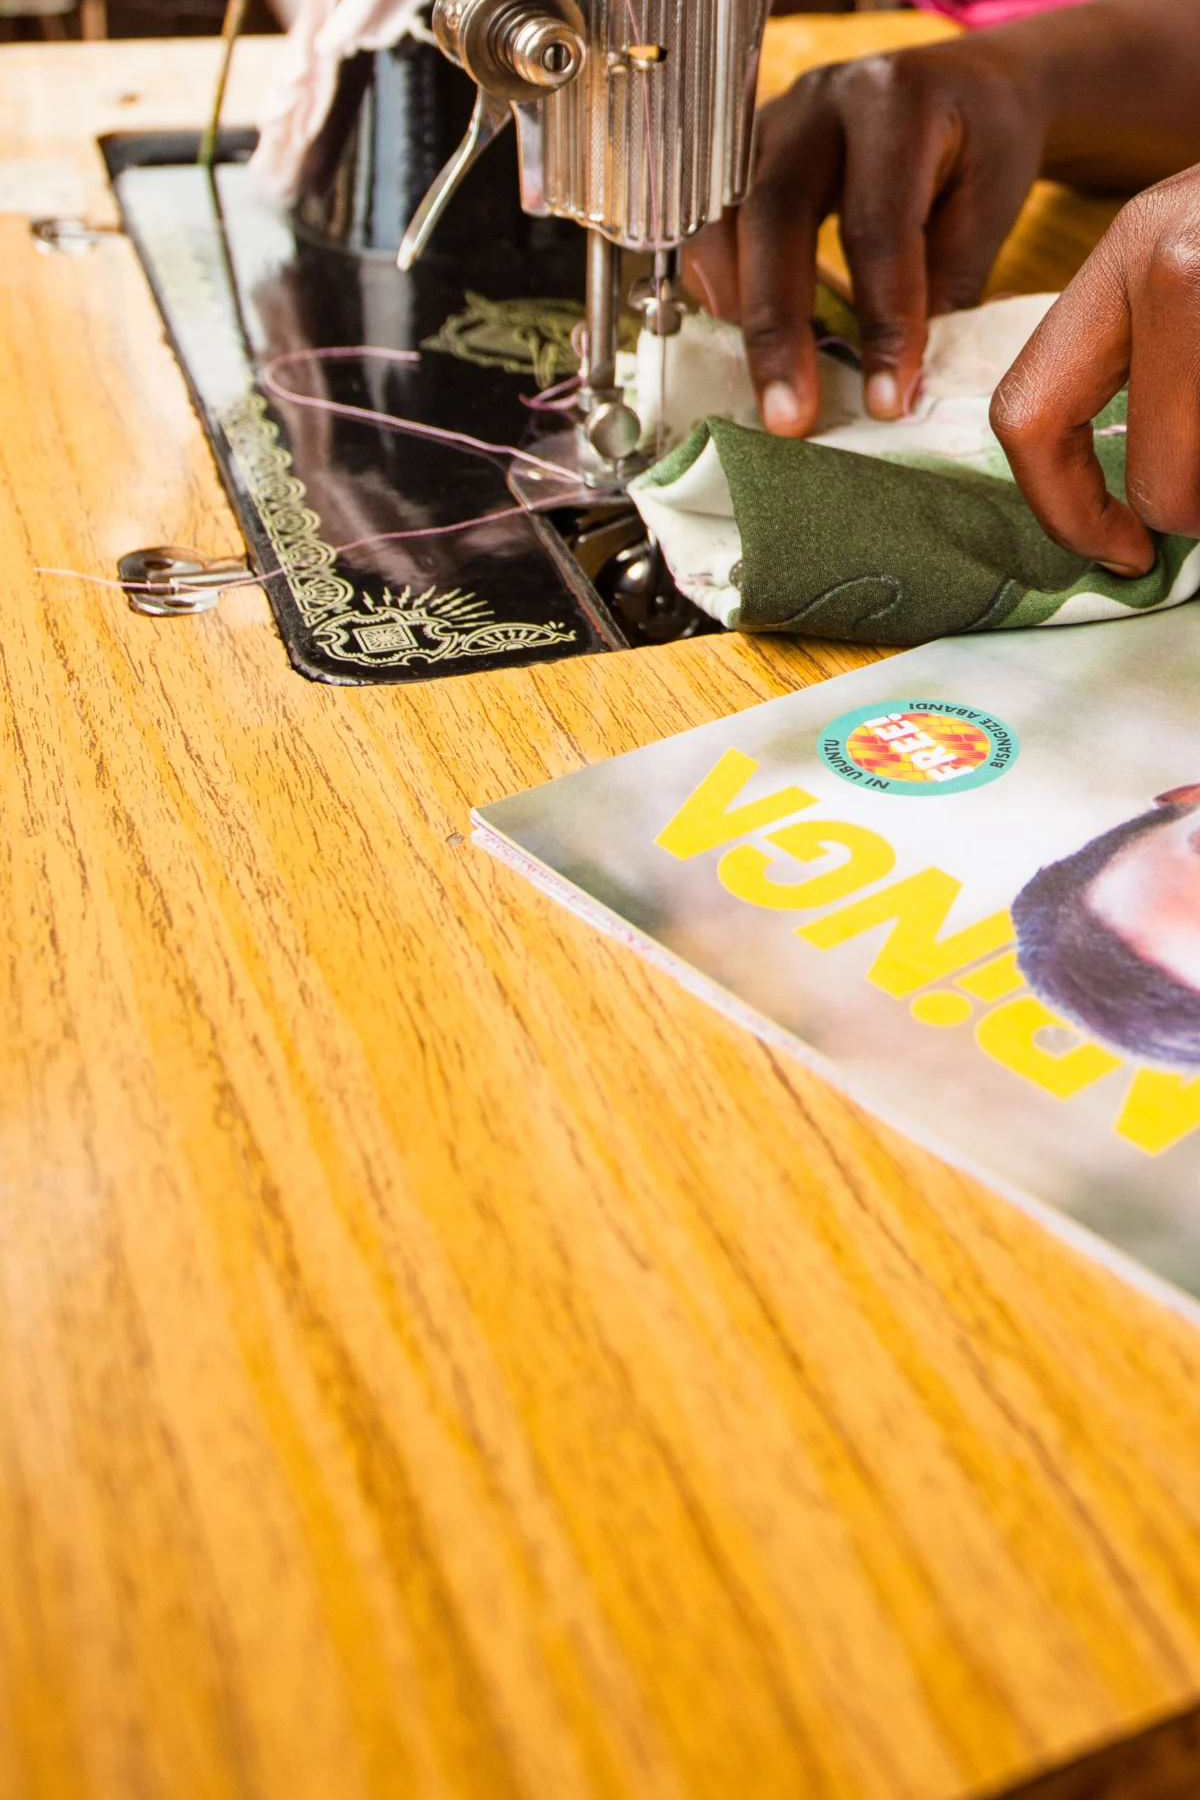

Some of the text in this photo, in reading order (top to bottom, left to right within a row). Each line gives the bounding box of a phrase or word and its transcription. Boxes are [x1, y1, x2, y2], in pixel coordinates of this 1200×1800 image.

[824, 738, 891, 790] NI UBUNTU
[863, 713, 976, 783] FREE!
[908, 702, 1012, 769] BISANGIZE ABANDI
